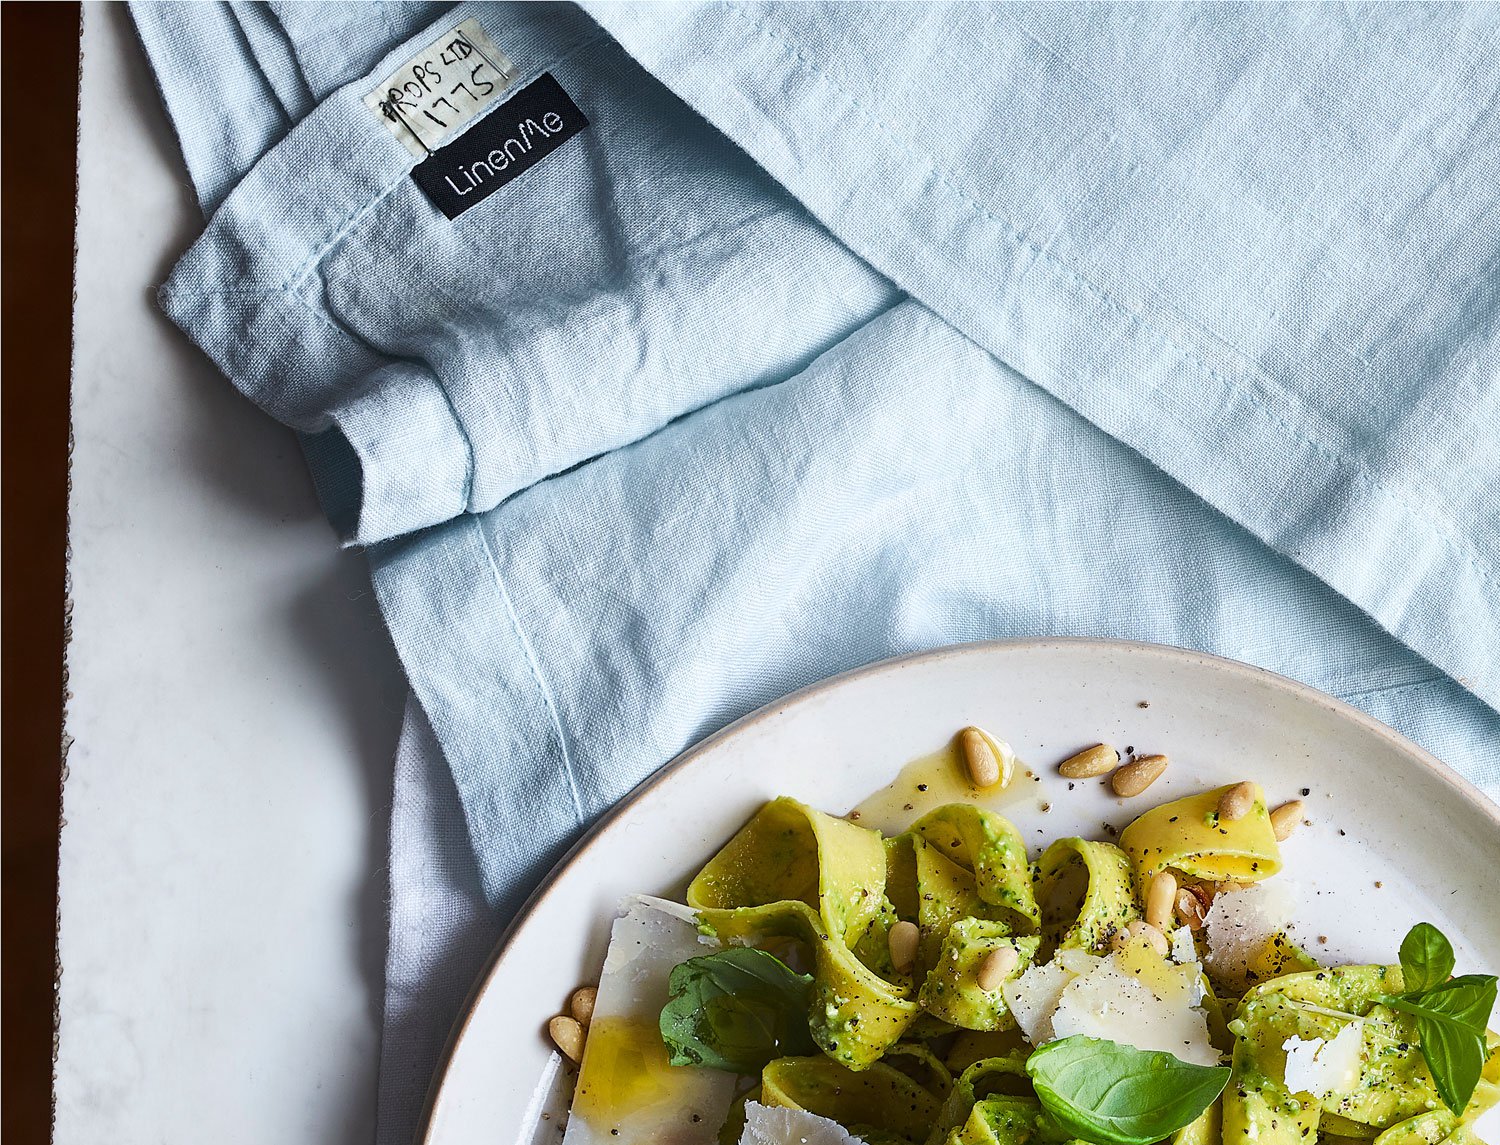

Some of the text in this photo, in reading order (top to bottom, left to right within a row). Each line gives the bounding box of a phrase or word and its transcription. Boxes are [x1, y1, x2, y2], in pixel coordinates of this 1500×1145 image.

[440, 38, 473, 66] LTD
[423, 64, 494, 127] 1775
[445, 112, 563, 195] LinenMe
